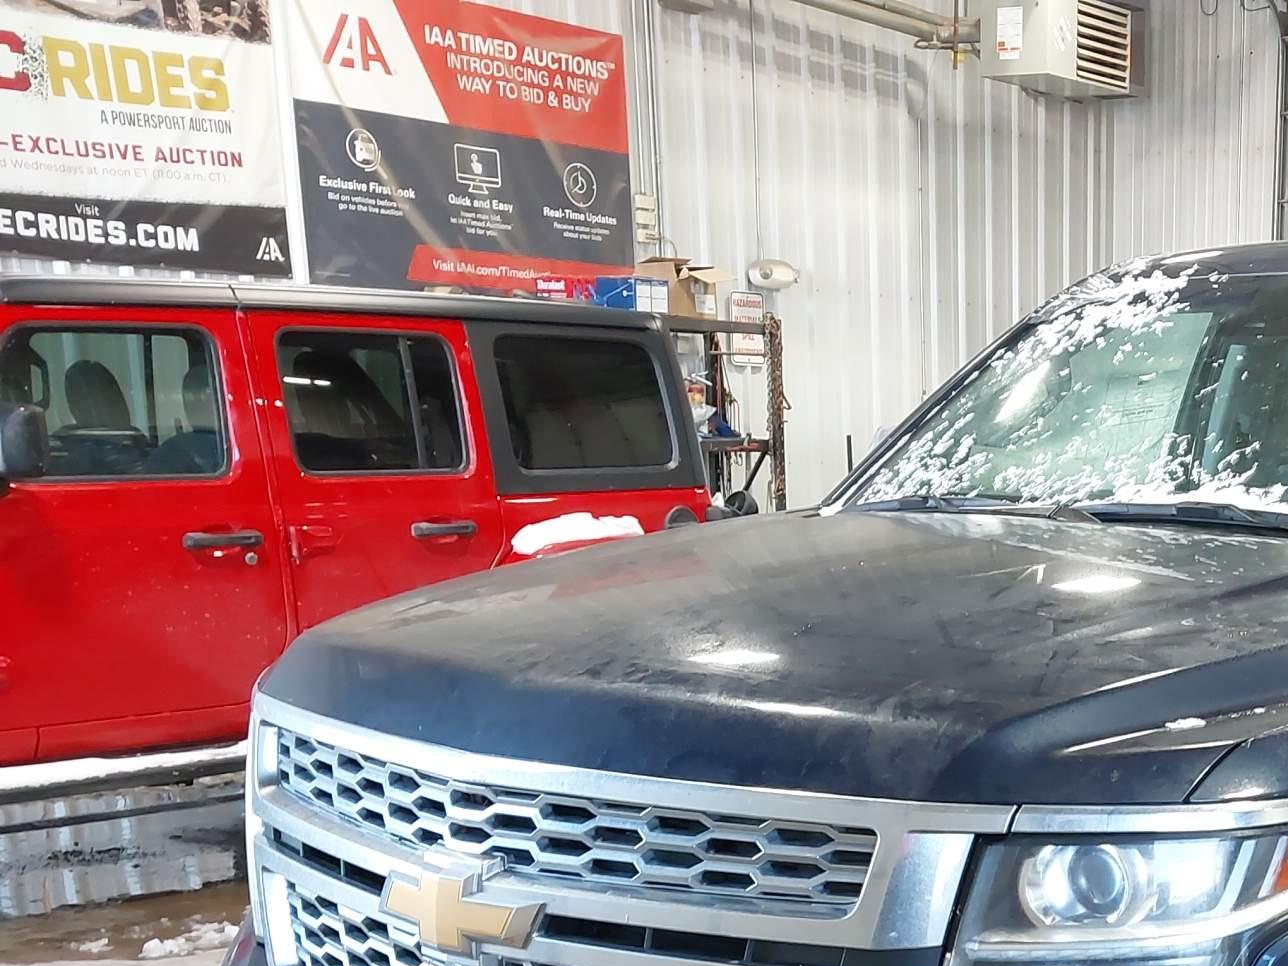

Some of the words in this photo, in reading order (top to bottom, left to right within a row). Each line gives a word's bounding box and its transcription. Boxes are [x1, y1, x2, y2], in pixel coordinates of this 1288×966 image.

[424, 24, 456, 49] IAA
[457, 32, 517, 60] TIMED
[42, 36, 230, 112] RIDES
[447, 52, 549, 86] INTRODUCING
[553, 74, 564, 90] A
[566, 76, 599, 96] NEW
[457, 74, 492, 94] WAY
[496, 80, 518, 99] TO
[521, 85, 544, 103] BID
[547, 91, 559, 107] &
[562, 94, 591, 112] BUY
[100, 109, 107, 125] A
[111, 110, 185, 131] POWERSPORT
[189, 117, 232, 134] AUCTION
[155, 146, 243, 167] AUCTION
[11, 159, 84, 175] Wednesdays
[87, 166, 98, 175] at
[102, 167, 130, 177] noon
[319, 175, 367, 192] Exclusive
[75, 203, 100, 216] Visit
[448, 193, 471, 207] Quick
[473, 199, 490, 209] and
[492, 199, 513, 213] Easy
[543, 207, 585, 221] Real-Time
[586, 212, 617, 226] Updates
[433, 259, 455, 272] Visit
